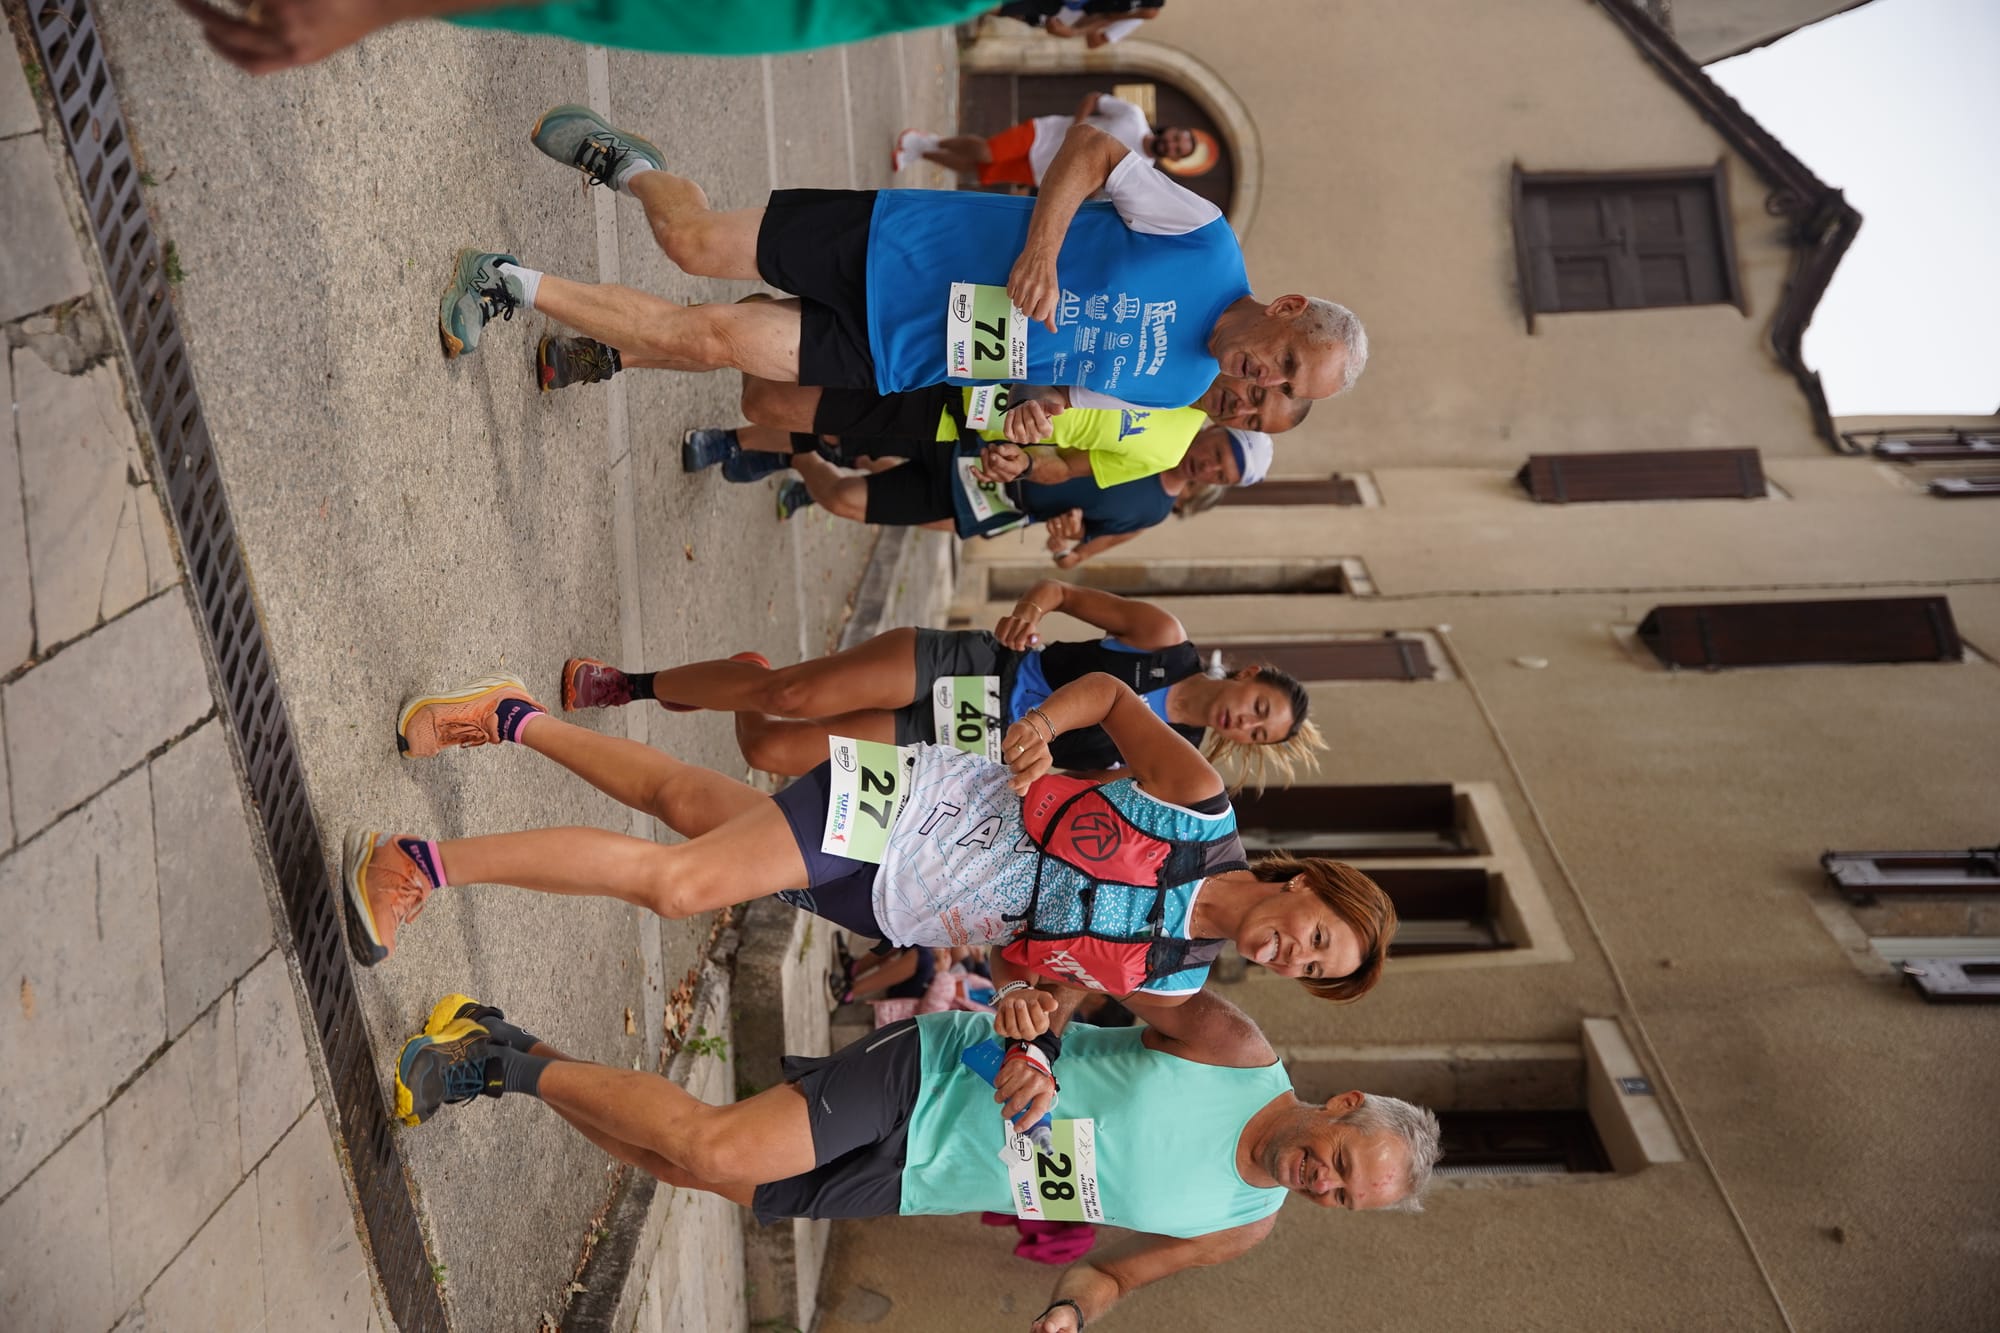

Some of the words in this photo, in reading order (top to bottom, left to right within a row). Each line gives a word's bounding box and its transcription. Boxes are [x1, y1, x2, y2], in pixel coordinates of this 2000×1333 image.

[975, 317, 1006, 361] 72
[956, 701, 983, 742] 40
[840, 746, 850, 768] BFP
[837, 793, 849, 830] TUFF'S
[859, 766, 895, 829] 27
[1021, 1181, 1032, 1206] TUFF'S
[1037, 1152, 1075, 1200] 28
[1087, 1177, 1096, 1206] Challenge
